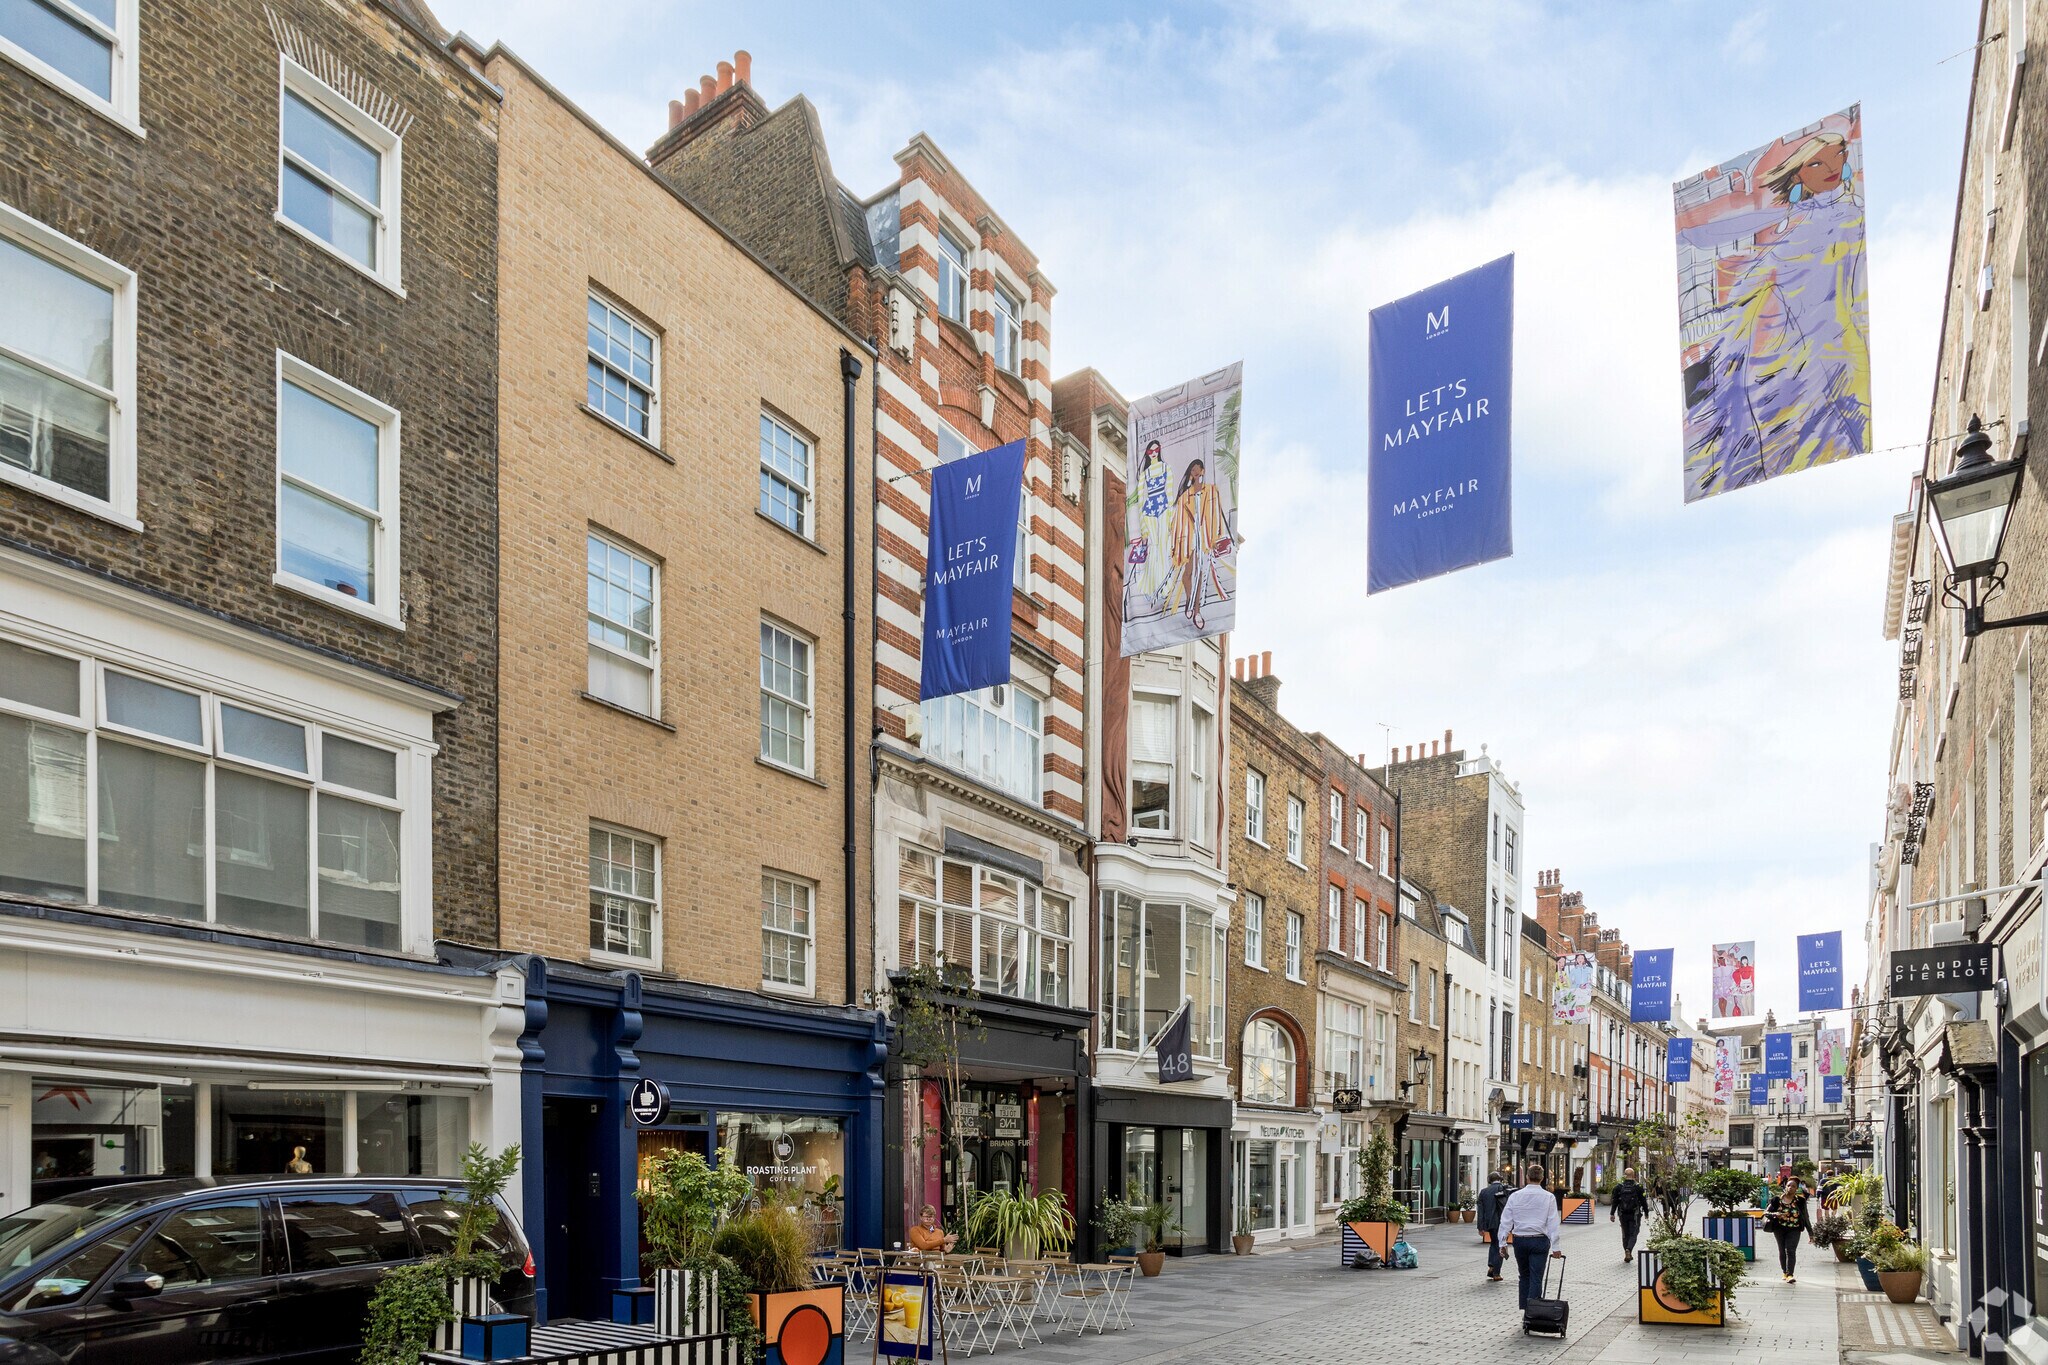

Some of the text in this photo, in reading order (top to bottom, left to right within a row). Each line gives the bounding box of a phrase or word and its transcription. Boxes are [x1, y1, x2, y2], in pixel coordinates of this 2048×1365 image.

[1426, 306, 1448, 334] M
[1406, 378, 1467, 417] LET'S
[1383, 398, 1490, 451] MAYFAIR
[965, 474, 982, 496] M
[1392, 478, 1479, 516] MAYFAIR
[1417, 504, 1454, 519] LONDON
[948, 536, 987, 562] LET'S
[934, 554, 999, 586] MAYFAIR
[936, 617, 988, 640] MAYFAIR
[952, 635, 973, 646] LONDON
[1804, 967, 1838, 976] MAYFAIR
[1896, 958, 1988, 974] CLAUDIE
[1896, 968, 1988, 982] PIERLOT
[1162, 1052, 1189, 1074] 48
[746, 1166, 816, 1174] ROASTING PLANT
